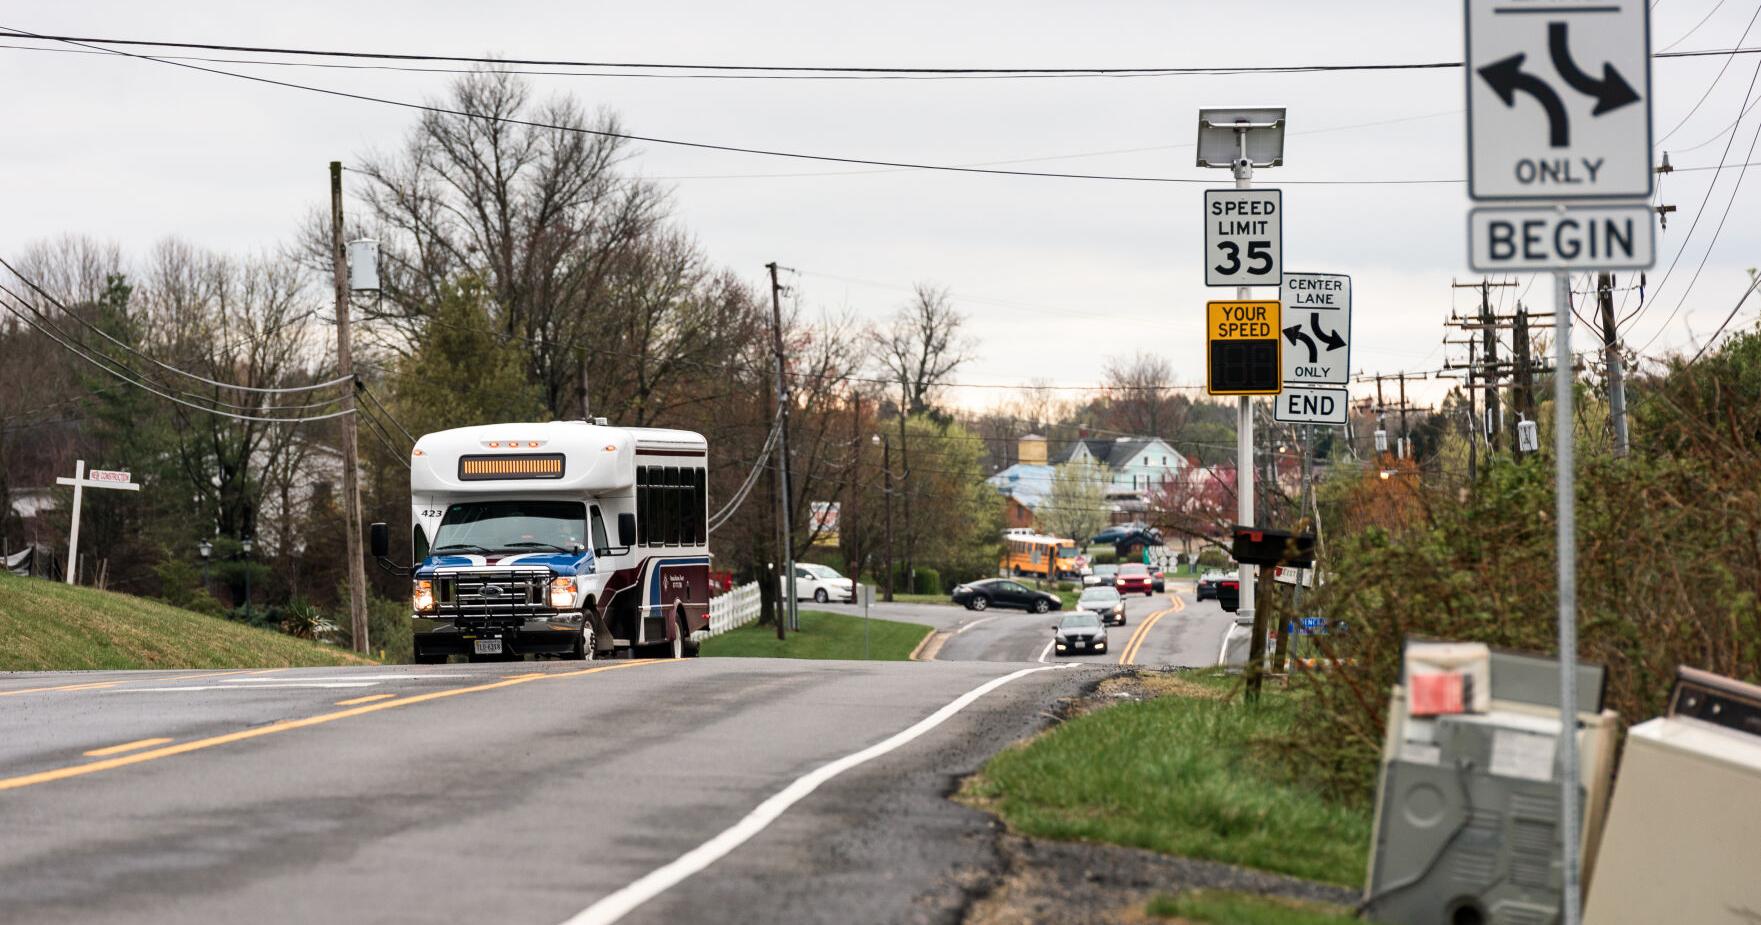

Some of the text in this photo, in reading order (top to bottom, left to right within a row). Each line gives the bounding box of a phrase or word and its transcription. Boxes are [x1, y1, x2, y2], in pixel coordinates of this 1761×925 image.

[1515, 157, 1604, 185] ONLY
[1211, 201, 1275, 216] SPEED
[1218, 220, 1268, 235] LIMIT
[1488, 218, 1634, 261] BEGIN
[1214, 240, 1273, 276] 35
[1289, 279, 1342, 291] CENTER
[1296, 294, 1334, 305] LANE
[1222, 306, 1266, 321] YOUR
[1218, 322, 1270, 337] SPEED
[1295, 366, 1331, 378] ONLY
[1288, 394, 1335, 416] END
[420, 509, 442, 518] 423
